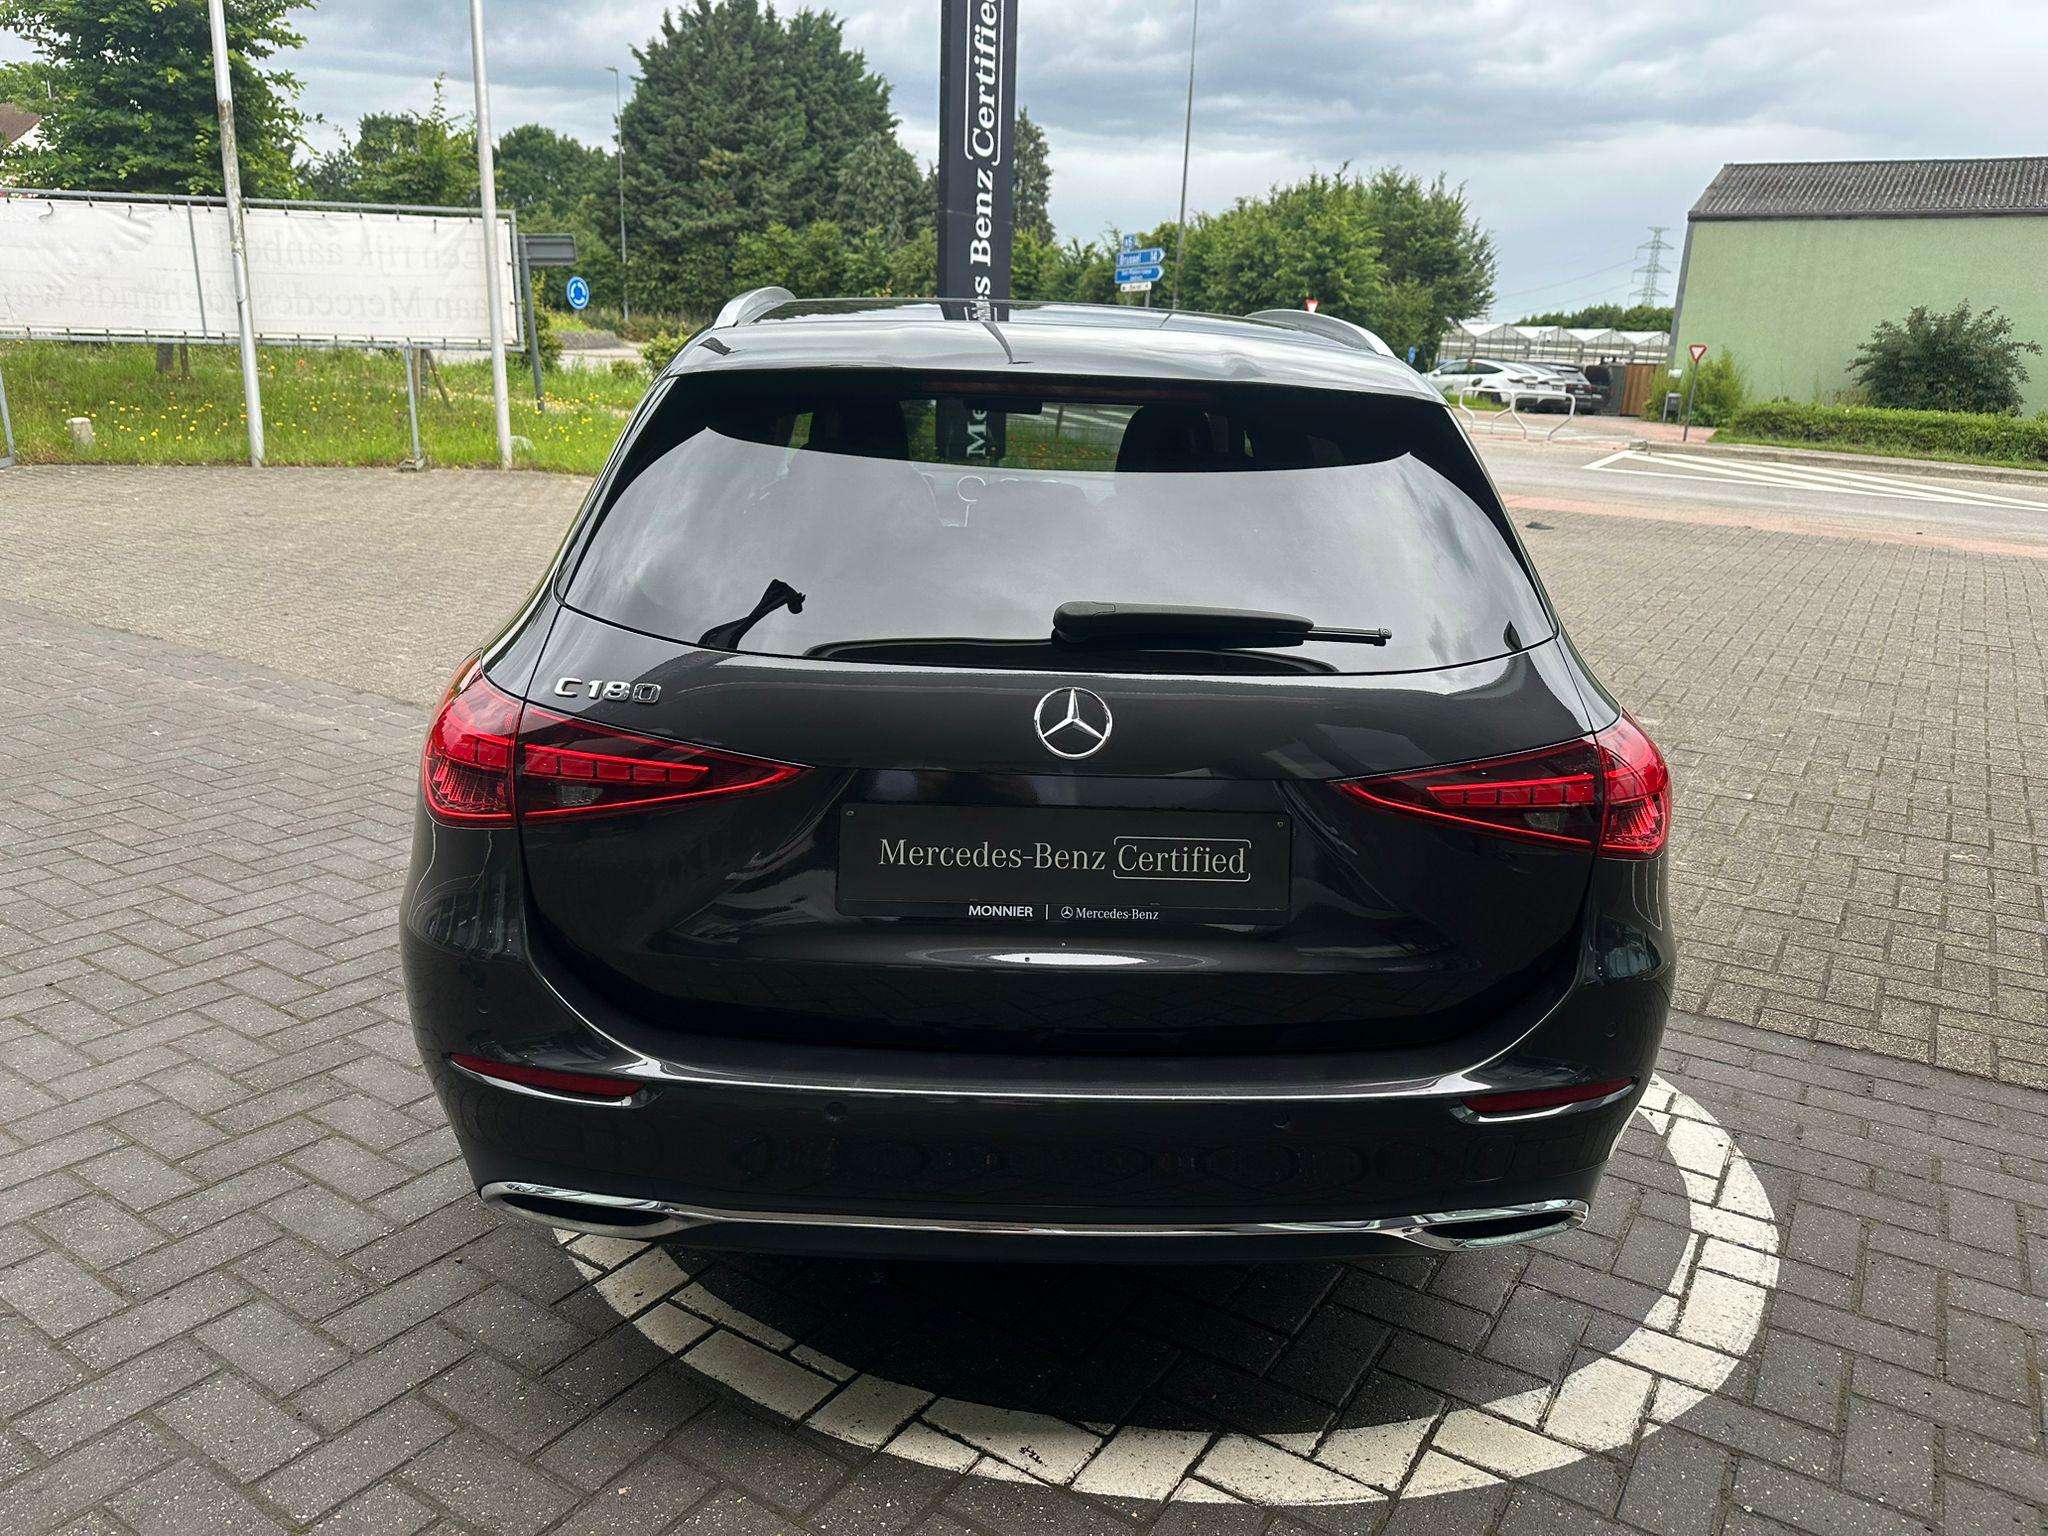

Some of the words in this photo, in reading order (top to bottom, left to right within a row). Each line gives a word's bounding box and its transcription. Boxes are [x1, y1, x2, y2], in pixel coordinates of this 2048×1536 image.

[972, 0, 998, 157] Certifie
[969, 168, 993, 267] Benz
[879, 838, 1106, 871] Mercedes-Benz
[1117, 843, 1246, 875] Certified
[968, 905, 1033, 918] MONNIER
[1076, 907, 1159, 920] Mercedes-Benz
